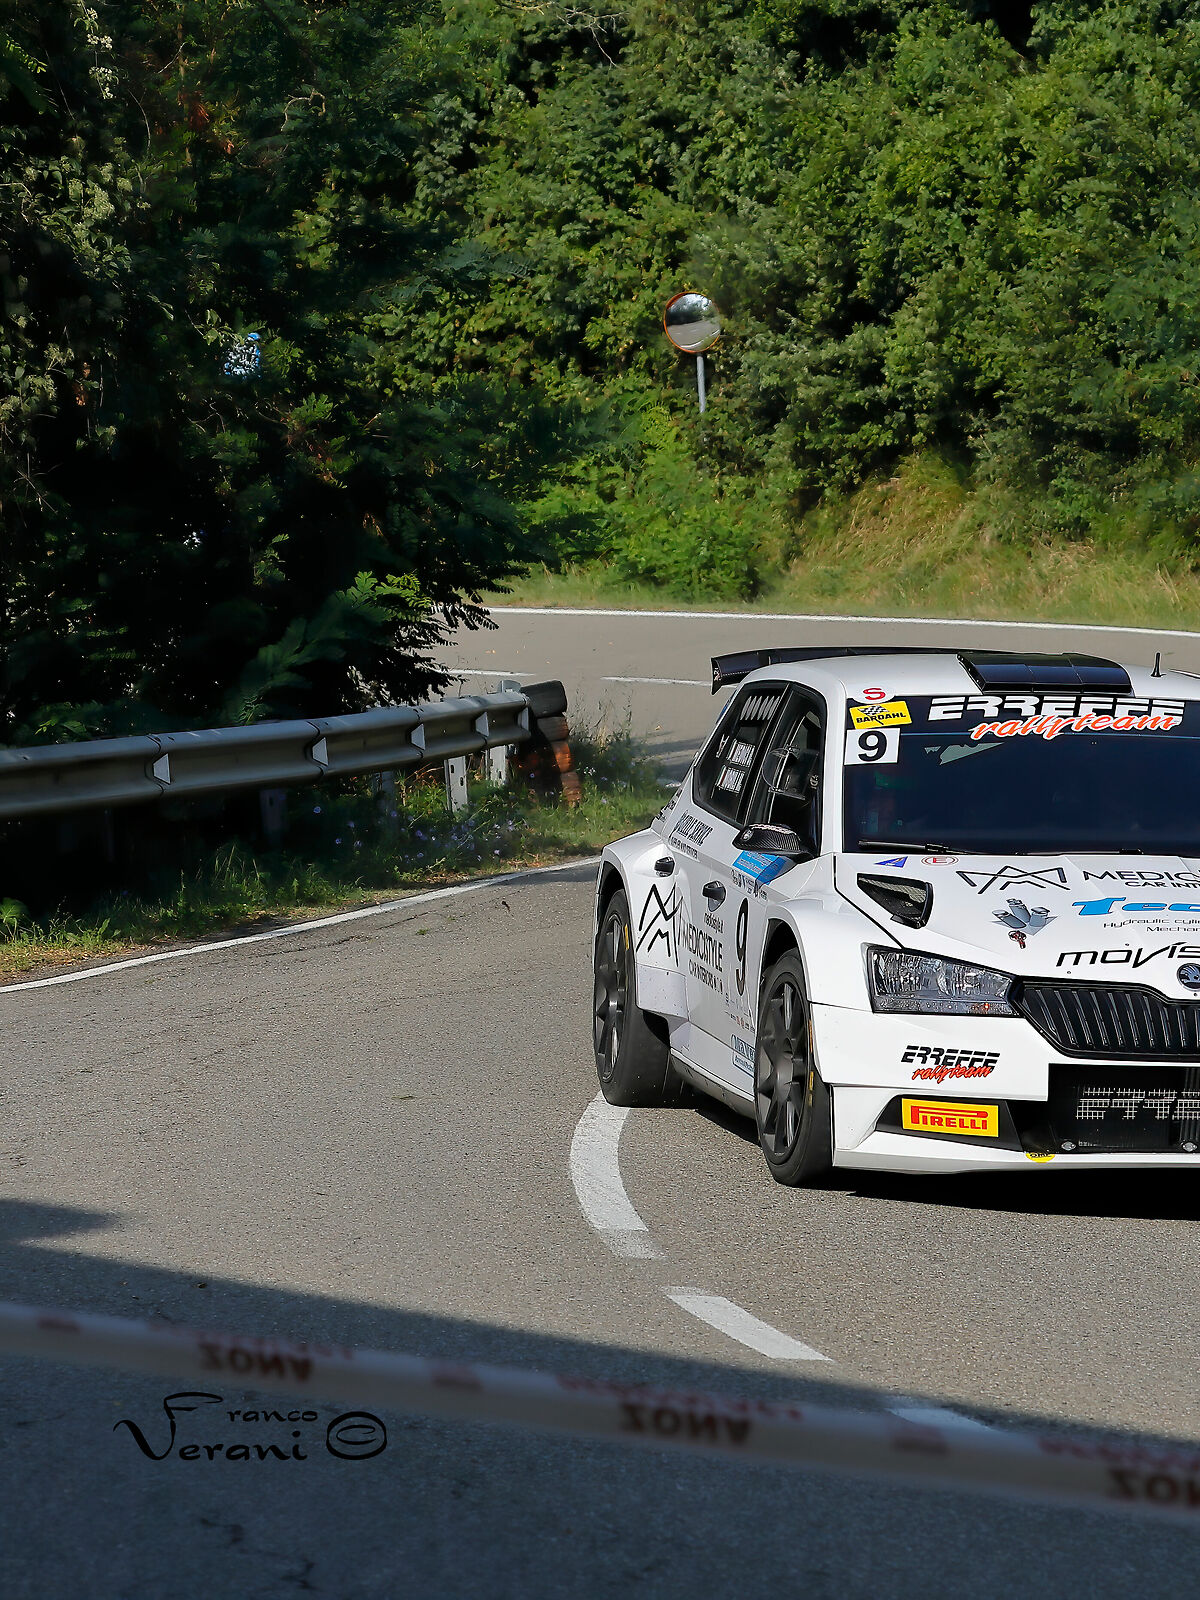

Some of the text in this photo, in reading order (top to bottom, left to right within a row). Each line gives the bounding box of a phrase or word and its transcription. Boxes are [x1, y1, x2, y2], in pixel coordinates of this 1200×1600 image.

[856, 712, 907, 724] BARDAHL
[928, 696, 1185, 728] ERREFFE
[857, 730, 888, 763] 9
[1103, 918, 1171, 929] Hydraulic
[736, 898, 749, 997] 9
[901, 1045, 1000, 1070] ERREFFE
[910, 1105, 988, 1130] PIRELLI
